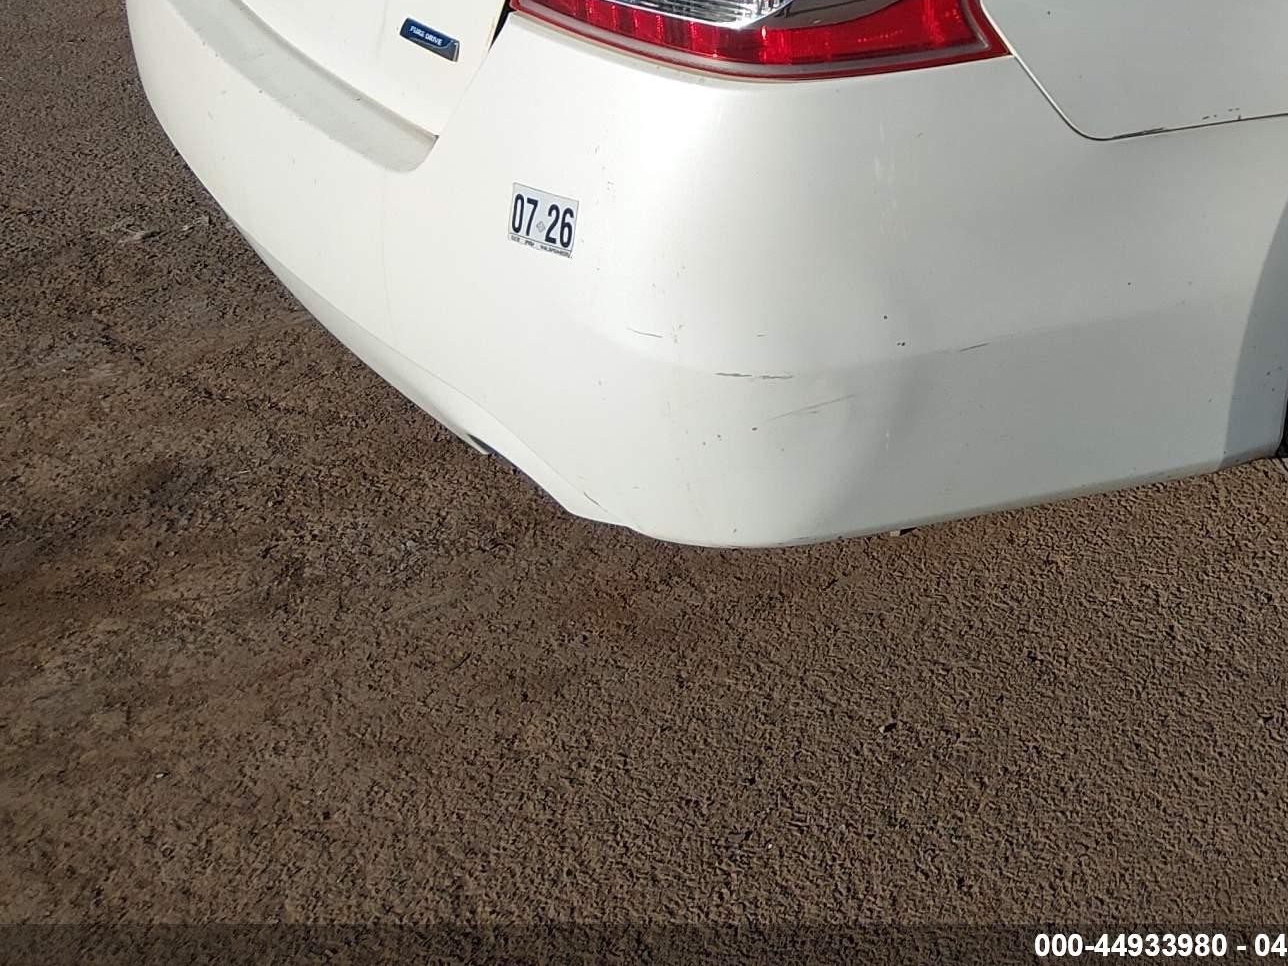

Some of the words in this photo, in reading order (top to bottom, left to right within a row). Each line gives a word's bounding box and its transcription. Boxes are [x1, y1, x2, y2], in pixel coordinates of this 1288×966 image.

[425, 33, 442, 46] DRIVE
[512, 194, 538, 236] 07
[545, 204, 574, 248] 26
